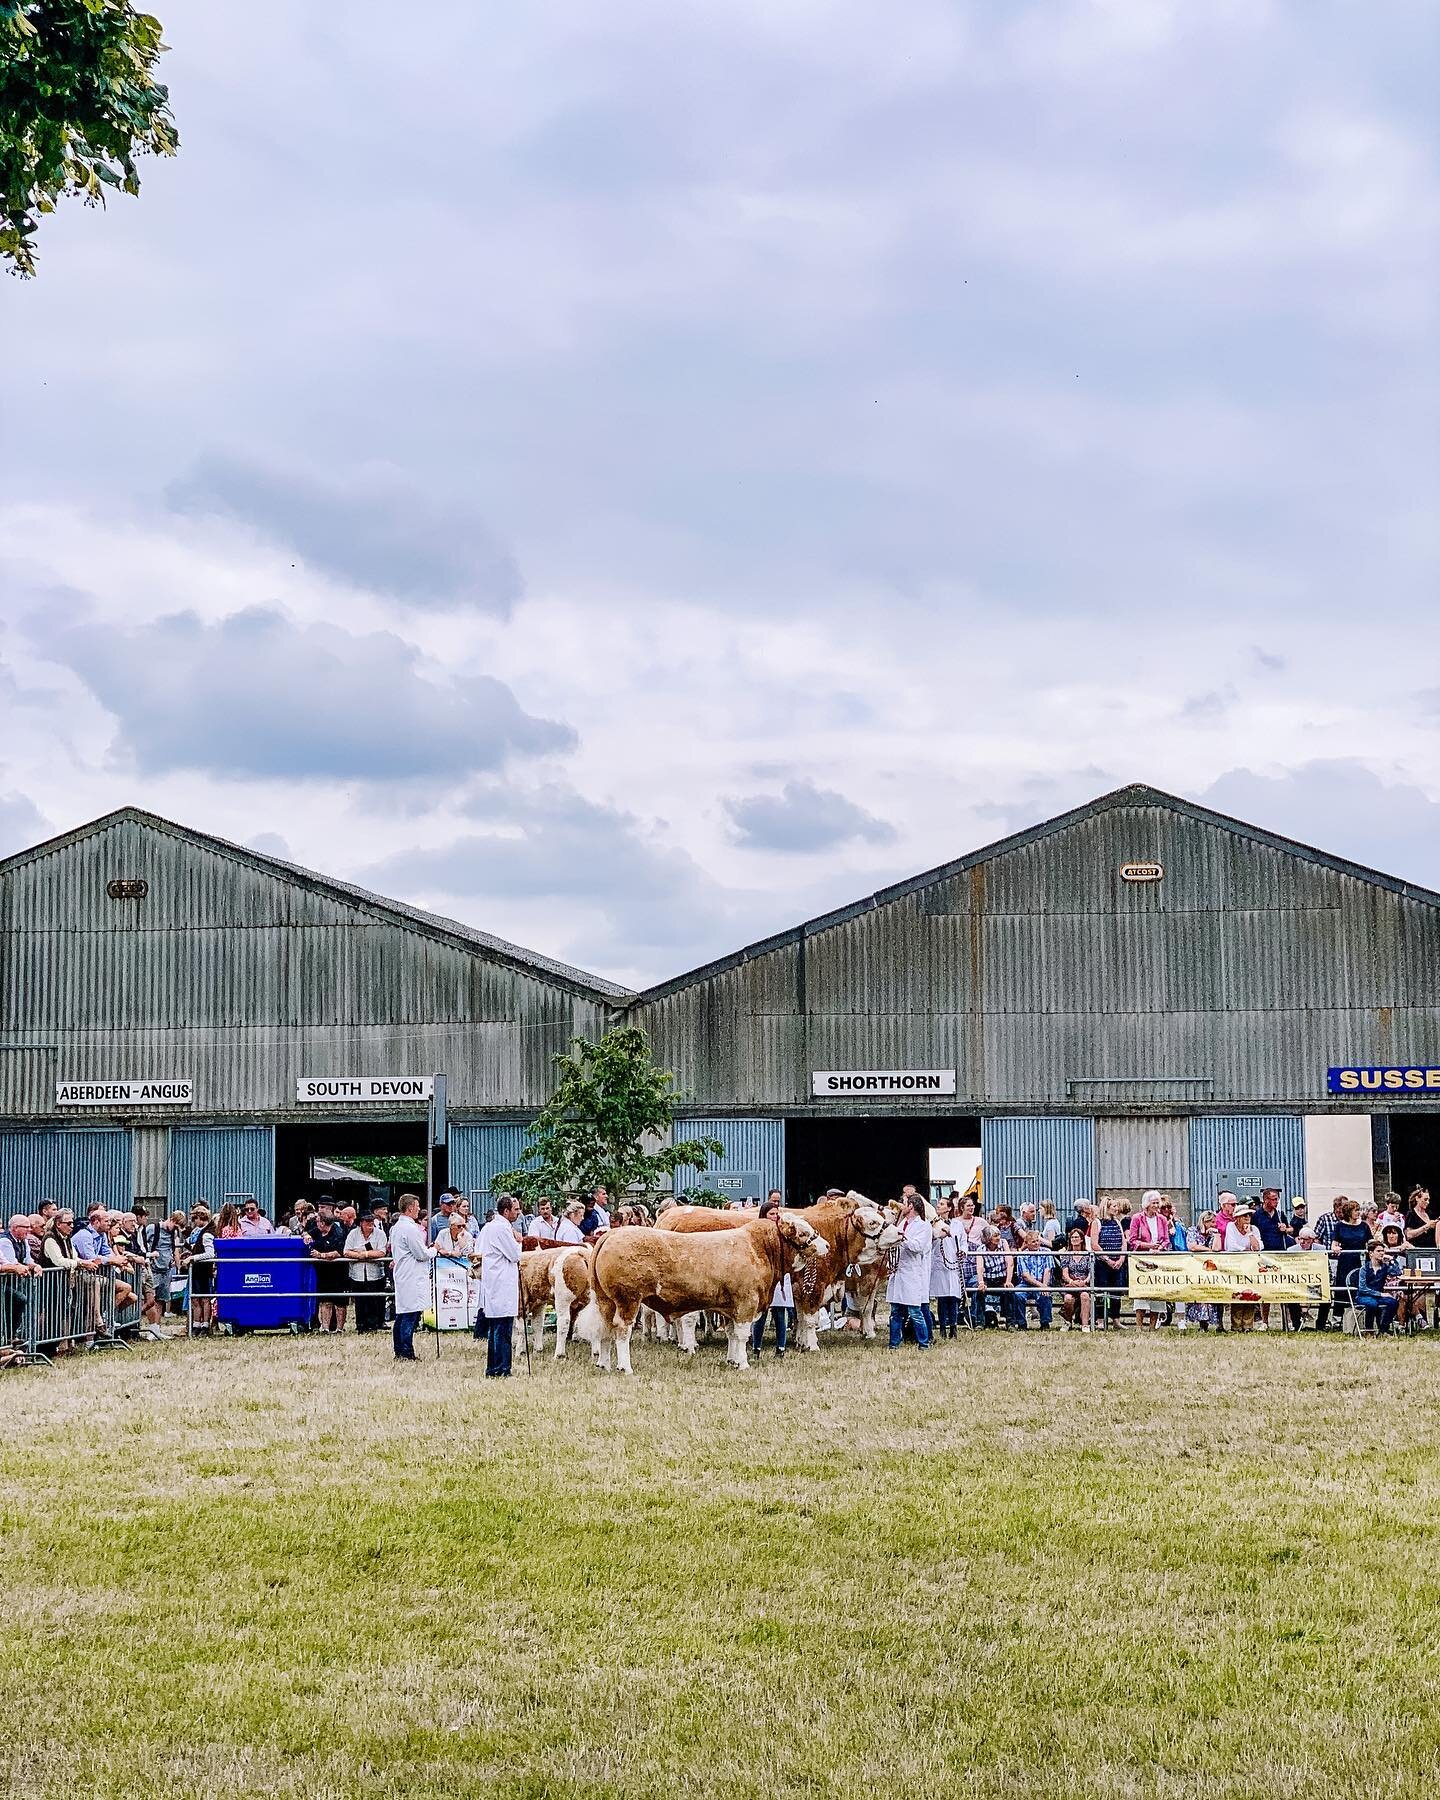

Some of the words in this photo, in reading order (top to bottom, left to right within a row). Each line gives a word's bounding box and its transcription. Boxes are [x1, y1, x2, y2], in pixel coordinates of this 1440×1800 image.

[307, 1082, 362, 1096] SOUTH
[371, 1081, 423, 1095] DEVON
[827, 1075, 941, 1090] SHORTHORN
[60, 1084, 189, 1100] ABERDEEN-ANGUS
[1136, 1275, 1194, 1285] CARRICK
[1198, 1275, 1232, 1285] FARM
[1236, 1273, 1322, 1285] ENTERPRISES
